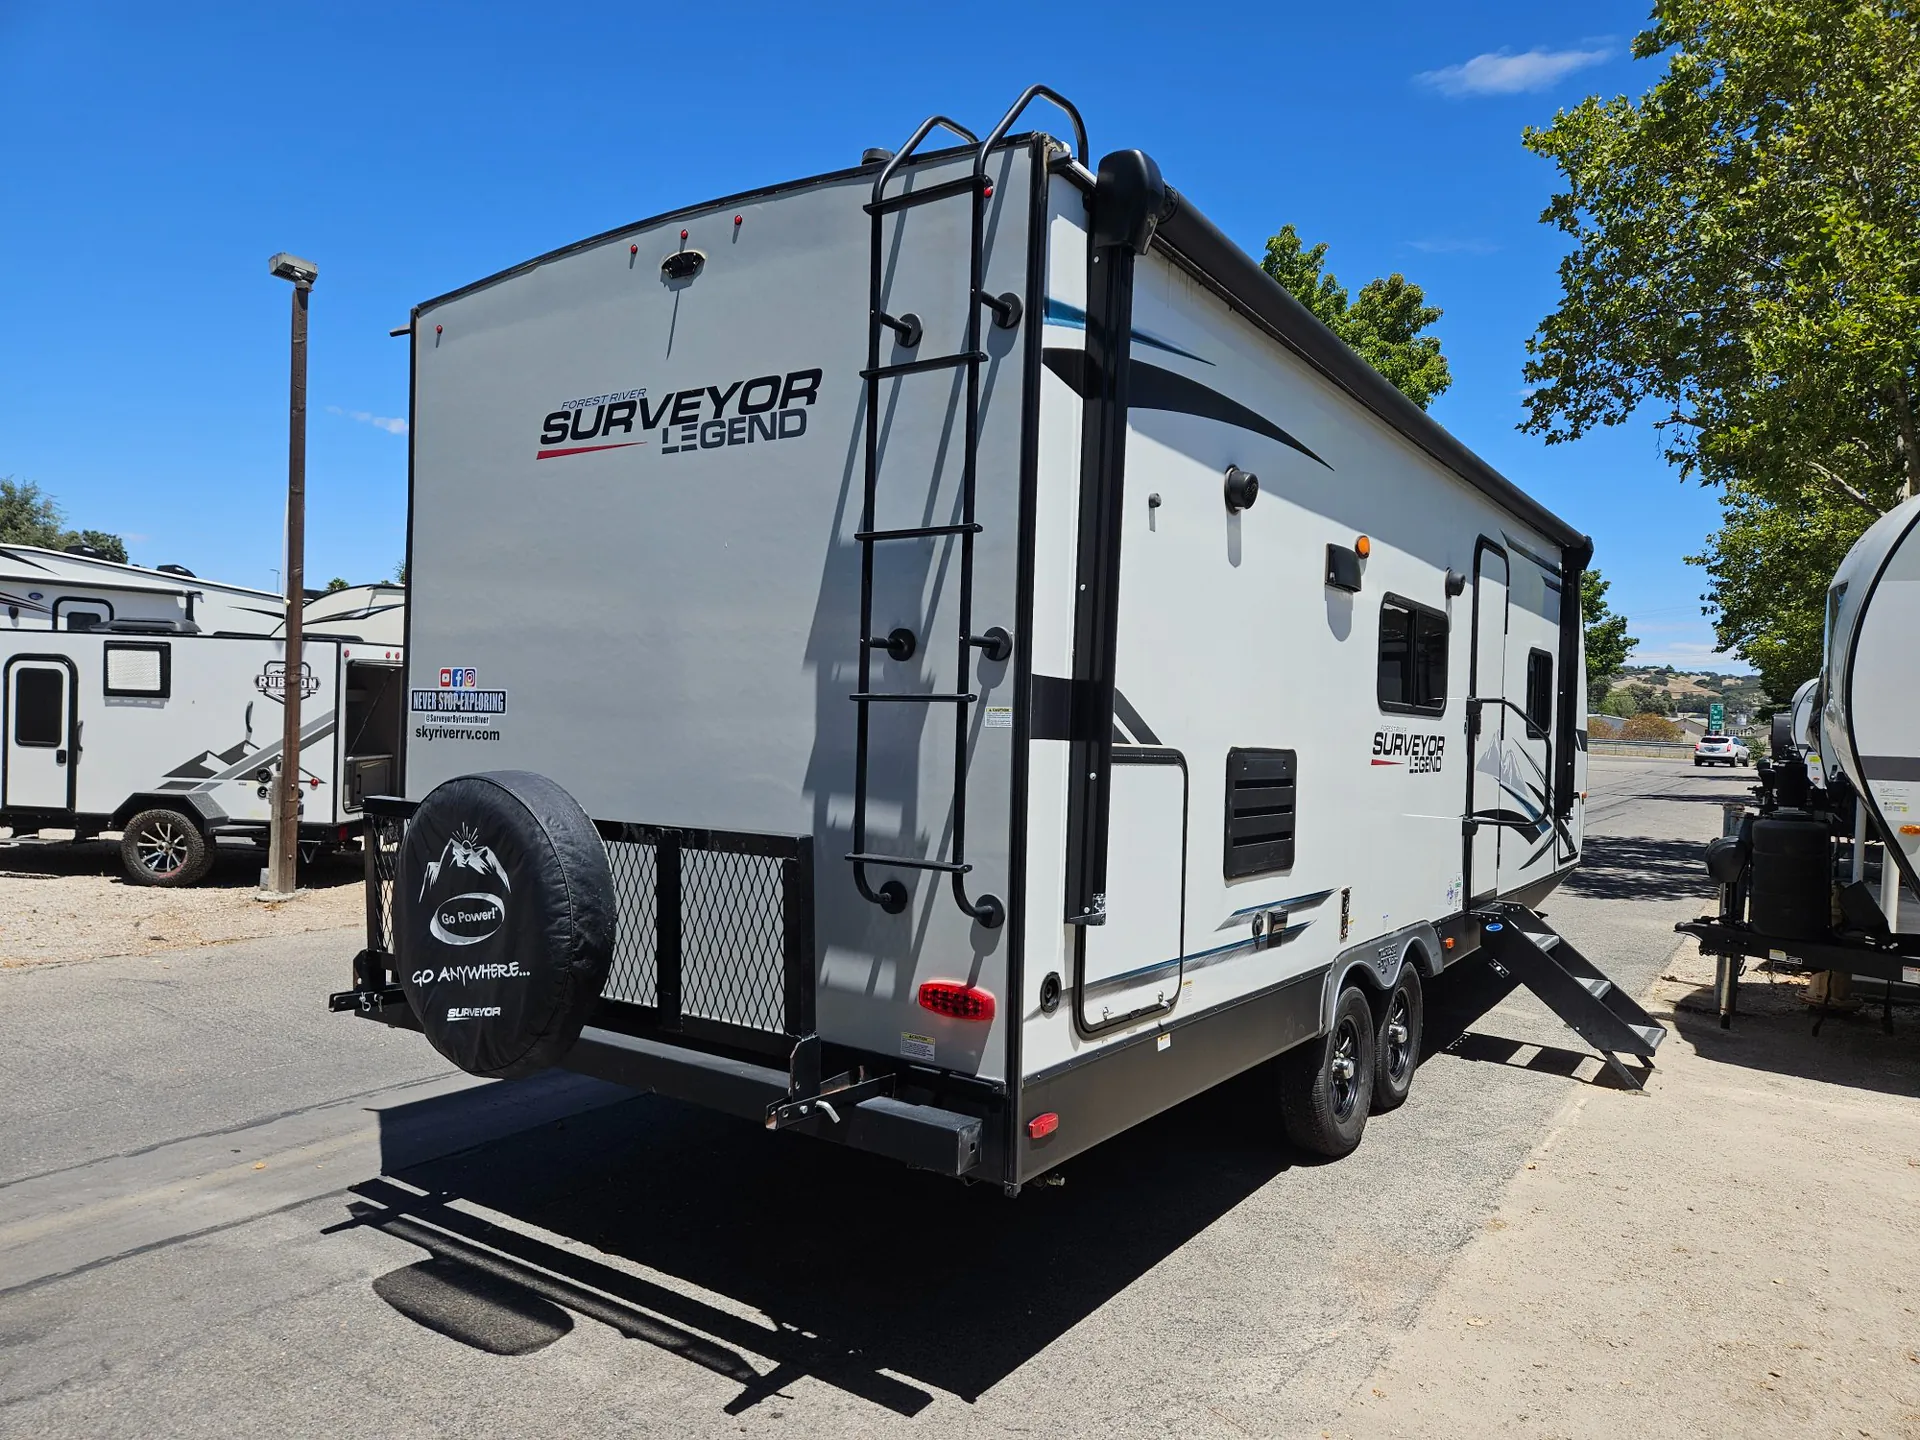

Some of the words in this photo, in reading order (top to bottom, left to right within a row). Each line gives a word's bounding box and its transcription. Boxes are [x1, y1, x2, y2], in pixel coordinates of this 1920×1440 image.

[540, 368, 823, 445] SURVEYOR
[561, 394, 608, 410] FOREST
[608, 388, 647, 403] RIVER
[661, 408, 807, 455] LEGEND
[258, 676, 317, 690] RUBON
[413, 691, 437, 710] NEVER
[415, 726, 500, 741] skyriverrv.com
[1373, 732, 1445, 756] SURVEYOR
[1409, 756, 1442, 773] LEGEND
[441, 913, 455, 925] Go
[457, 908, 496, 923] Power!
[411, 969, 434, 987] GO
[437, 961, 530, 986] ANYWHERE...
[447, 1006, 501, 1018] SURVEYOR
